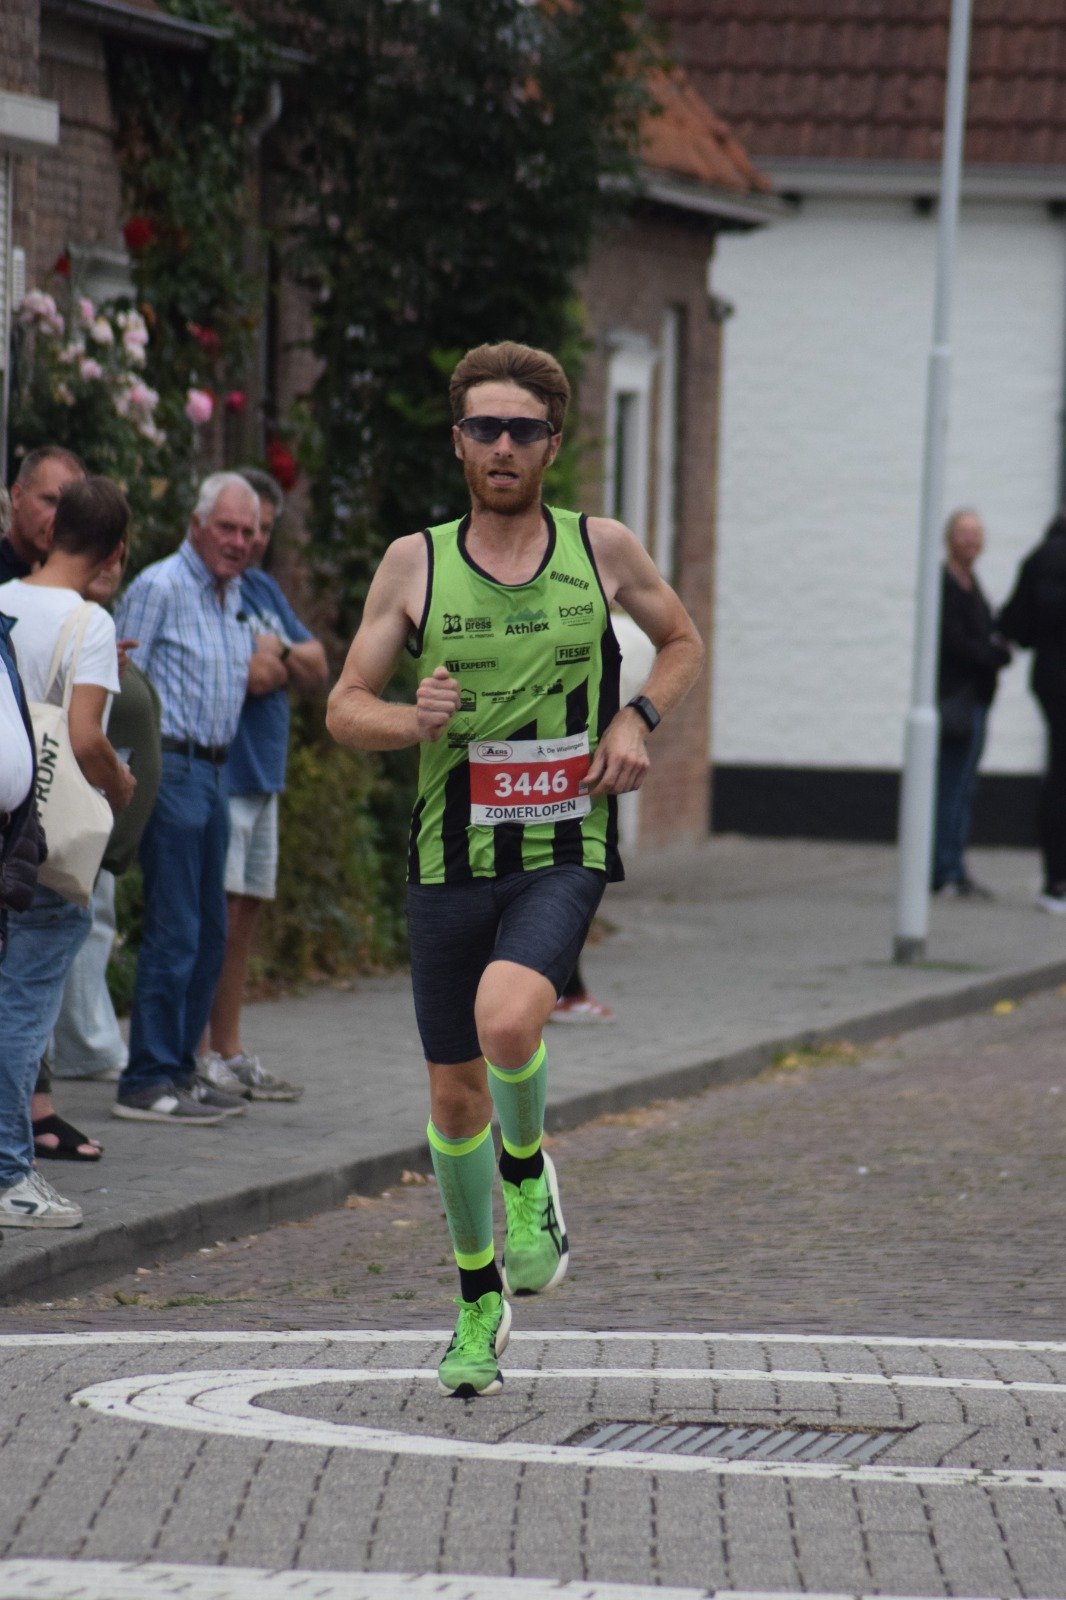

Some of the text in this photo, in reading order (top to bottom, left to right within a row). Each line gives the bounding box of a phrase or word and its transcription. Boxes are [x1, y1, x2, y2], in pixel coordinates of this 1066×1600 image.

[550, 571, 589, 590] BIORACER
[465, 621, 492, 632] press
[461, 660, 495, 669] EXPERTS
[494, 769, 568, 798] 3446
[485, 801, 576, 818] ZOMERLOPEN
